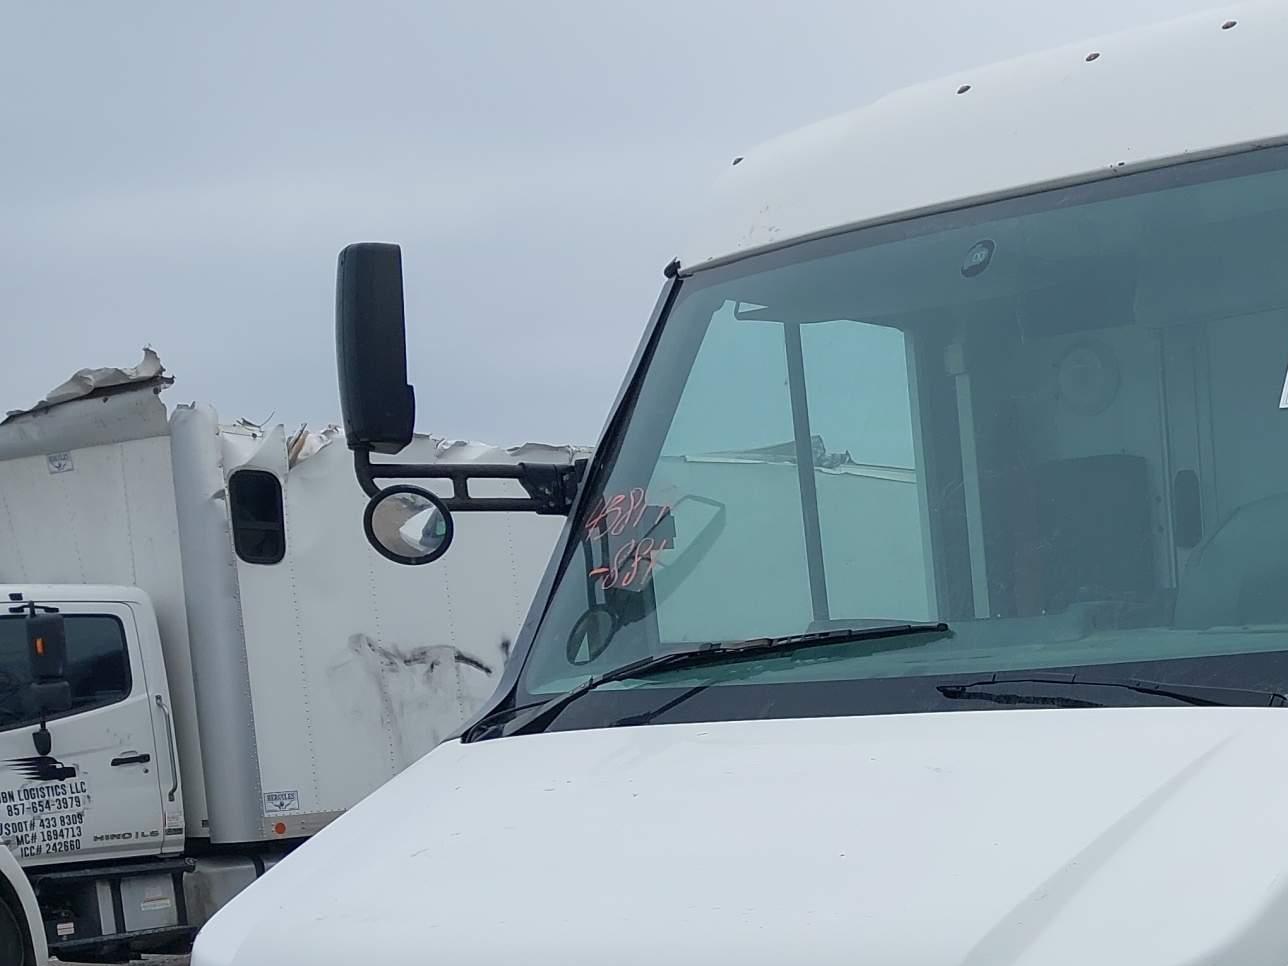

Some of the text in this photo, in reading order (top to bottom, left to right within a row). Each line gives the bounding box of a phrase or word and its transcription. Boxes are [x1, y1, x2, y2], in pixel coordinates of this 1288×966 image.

[17, 784, 67, 801] LOGISTICS
[69, 781, 86, 794] LLC
[7, 796, 81, 816] 857-654-3979
[40, 817, 57, 829] 433
[60, 813, 83, 827] 8309
[16, 832, 37, 845] MC#
[93, 831, 133, 841] HINO
[20, 839, 81, 858] ICC# 242660
